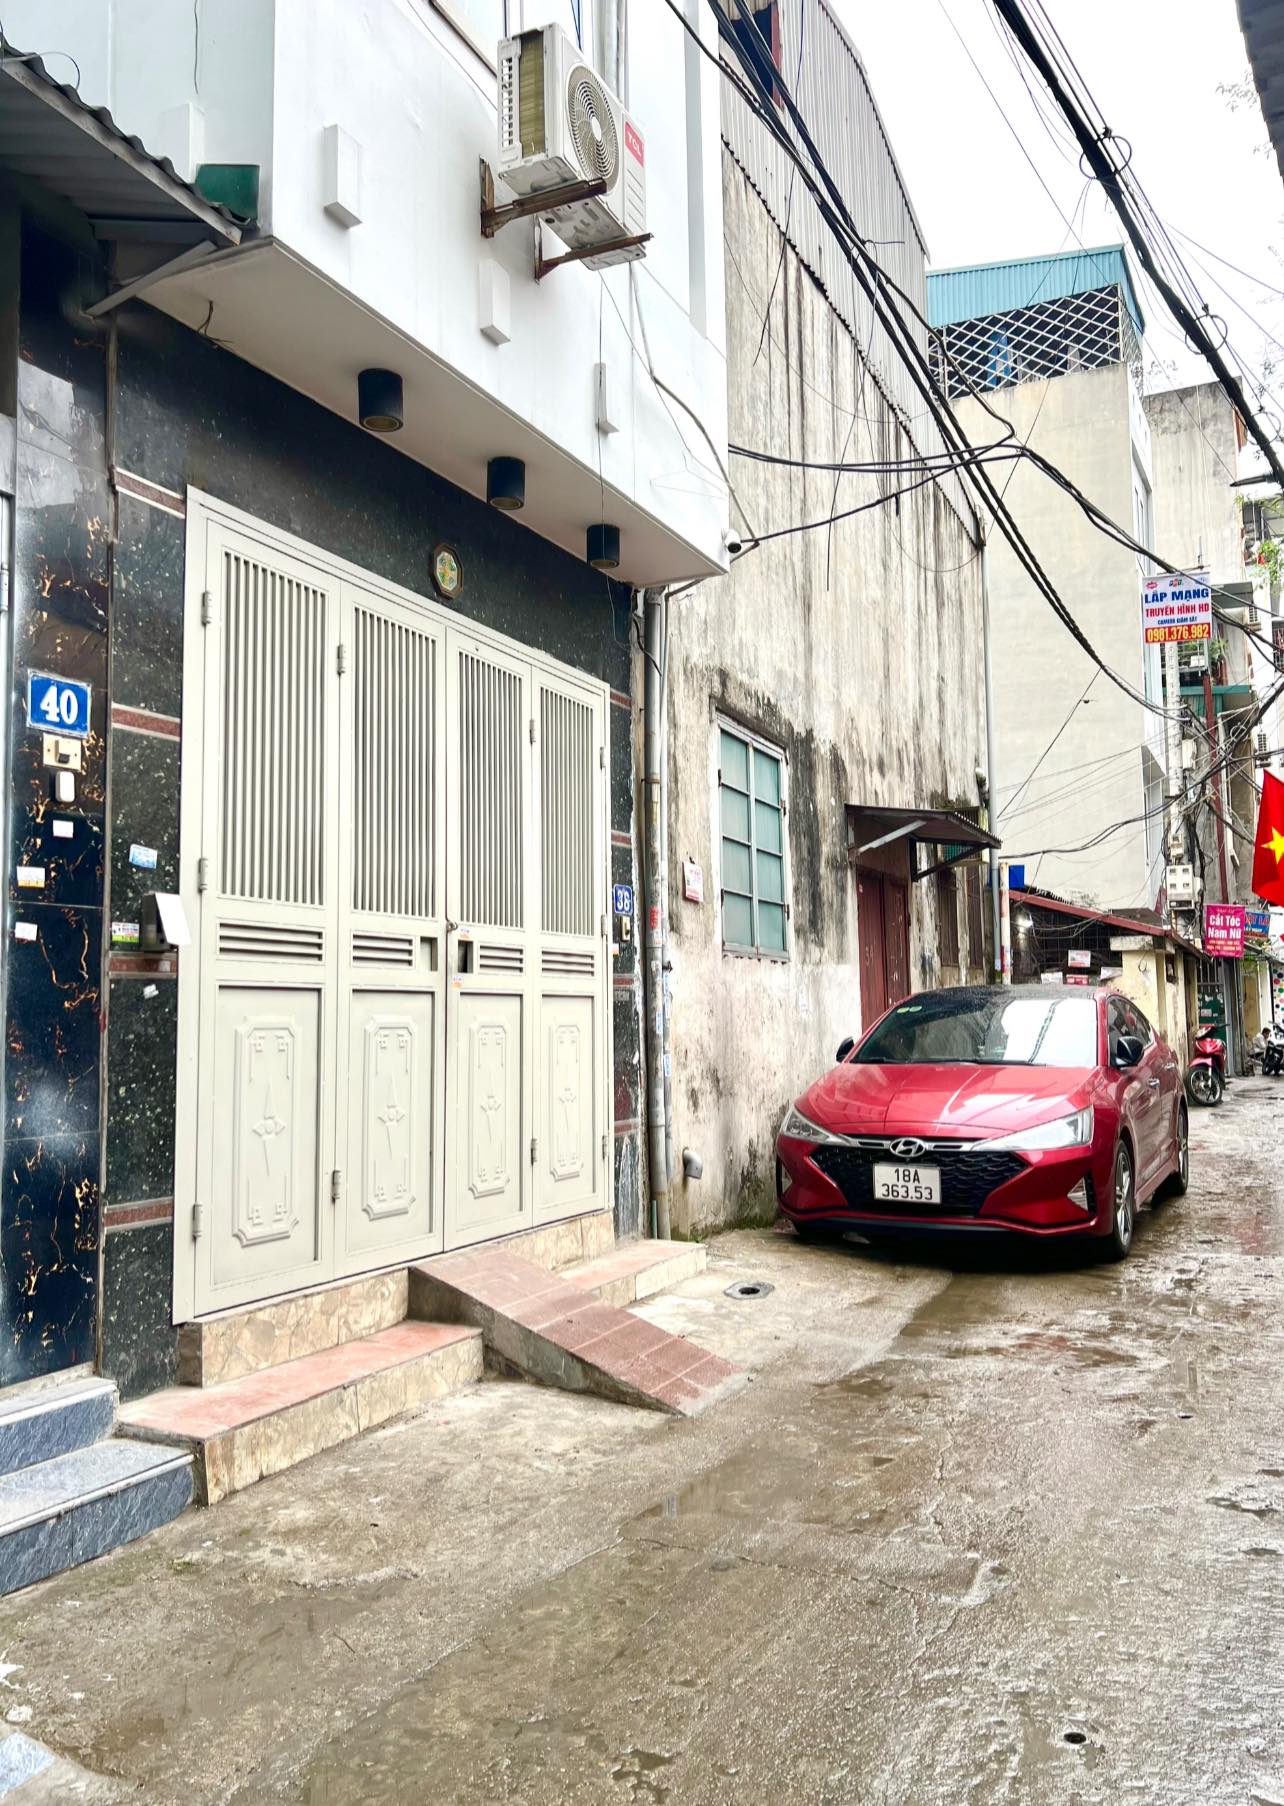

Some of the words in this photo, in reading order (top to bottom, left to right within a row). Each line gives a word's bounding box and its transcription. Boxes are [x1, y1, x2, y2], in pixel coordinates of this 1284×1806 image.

[627, 130, 642, 157] TCL
[1171, 588, 1209, 602] MẠNG
[1177, 603, 1196, 615] HÌNH
[1198, 603, 1210, 612] HD
[1147, 624, 1209, 642] 0981.376.982
[40, 684, 78, 725] 40
[1226, 915, 1241, 927] Tóc
[1208, 927, 1227, 938] Nam
[894, 1168, 921, 1184] 18A
[881, 1183, 933, 1201] 363.53
